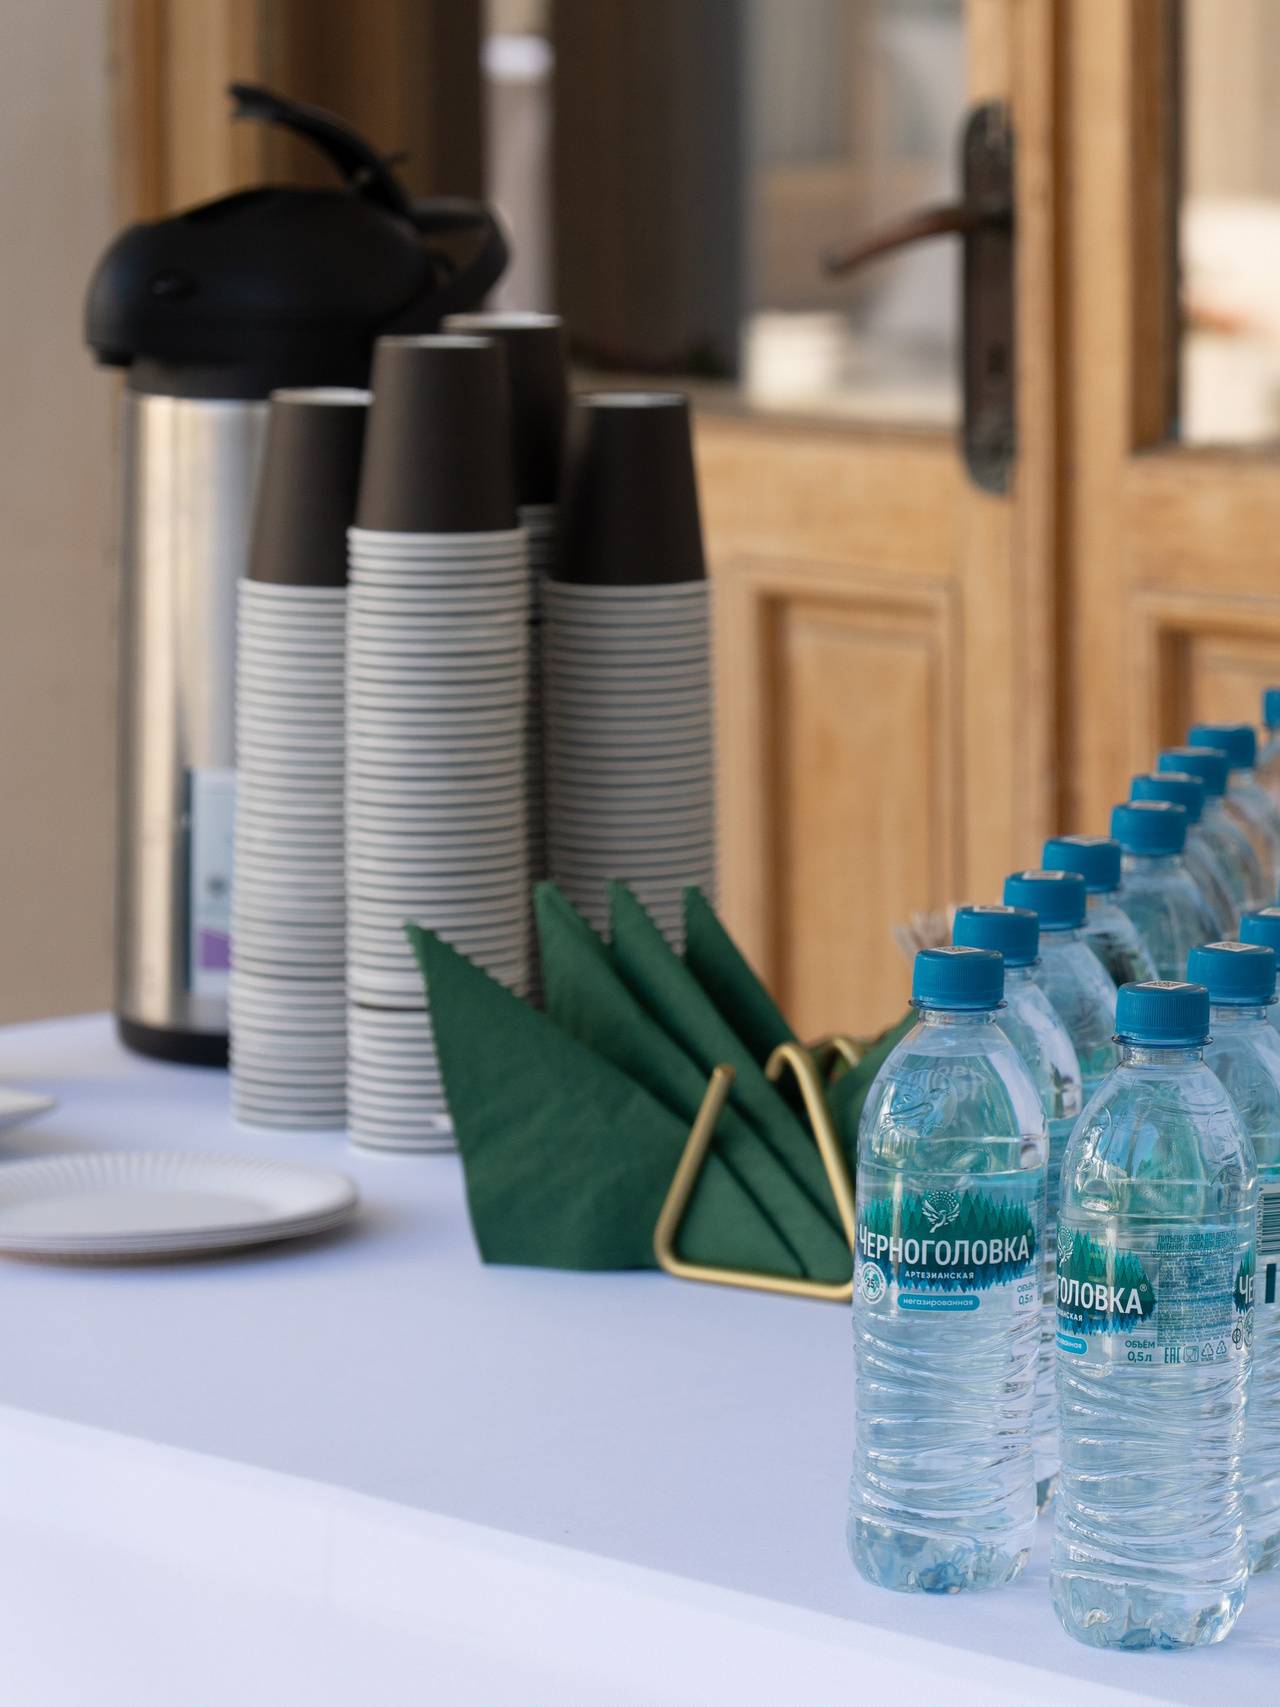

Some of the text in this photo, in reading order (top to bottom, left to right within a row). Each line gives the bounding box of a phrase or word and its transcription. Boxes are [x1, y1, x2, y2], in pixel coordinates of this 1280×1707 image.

[859, 1224, 1030, 1266] ЧЕРНОГОЛОВКА
[904, 1270, 975, 1280] АРТЕЗИАНСКАЯ
[902, 1297, 974, 1307] негазированная
[1125, 1340, 1155, 1348] ОБЪЁМ
[1127, 1351, 1144, 1363] 0,5
